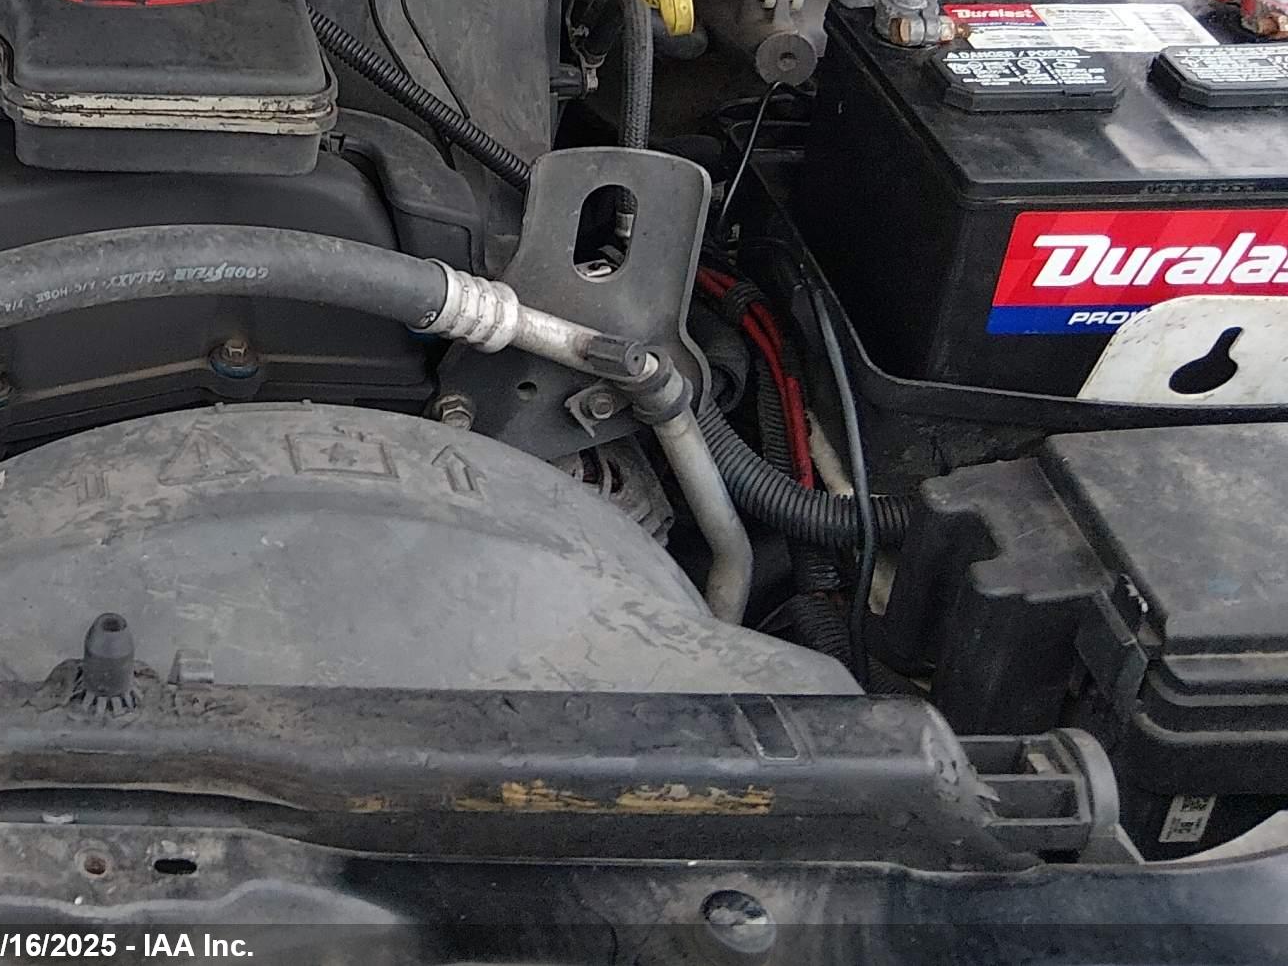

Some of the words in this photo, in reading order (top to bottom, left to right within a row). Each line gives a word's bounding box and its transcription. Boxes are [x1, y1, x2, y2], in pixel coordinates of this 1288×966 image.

[951, 7, 1034, 20] Duralast
[1032, 232, 1288, 287] Durala
[173, 262, 269, 283] GOODYEAR
